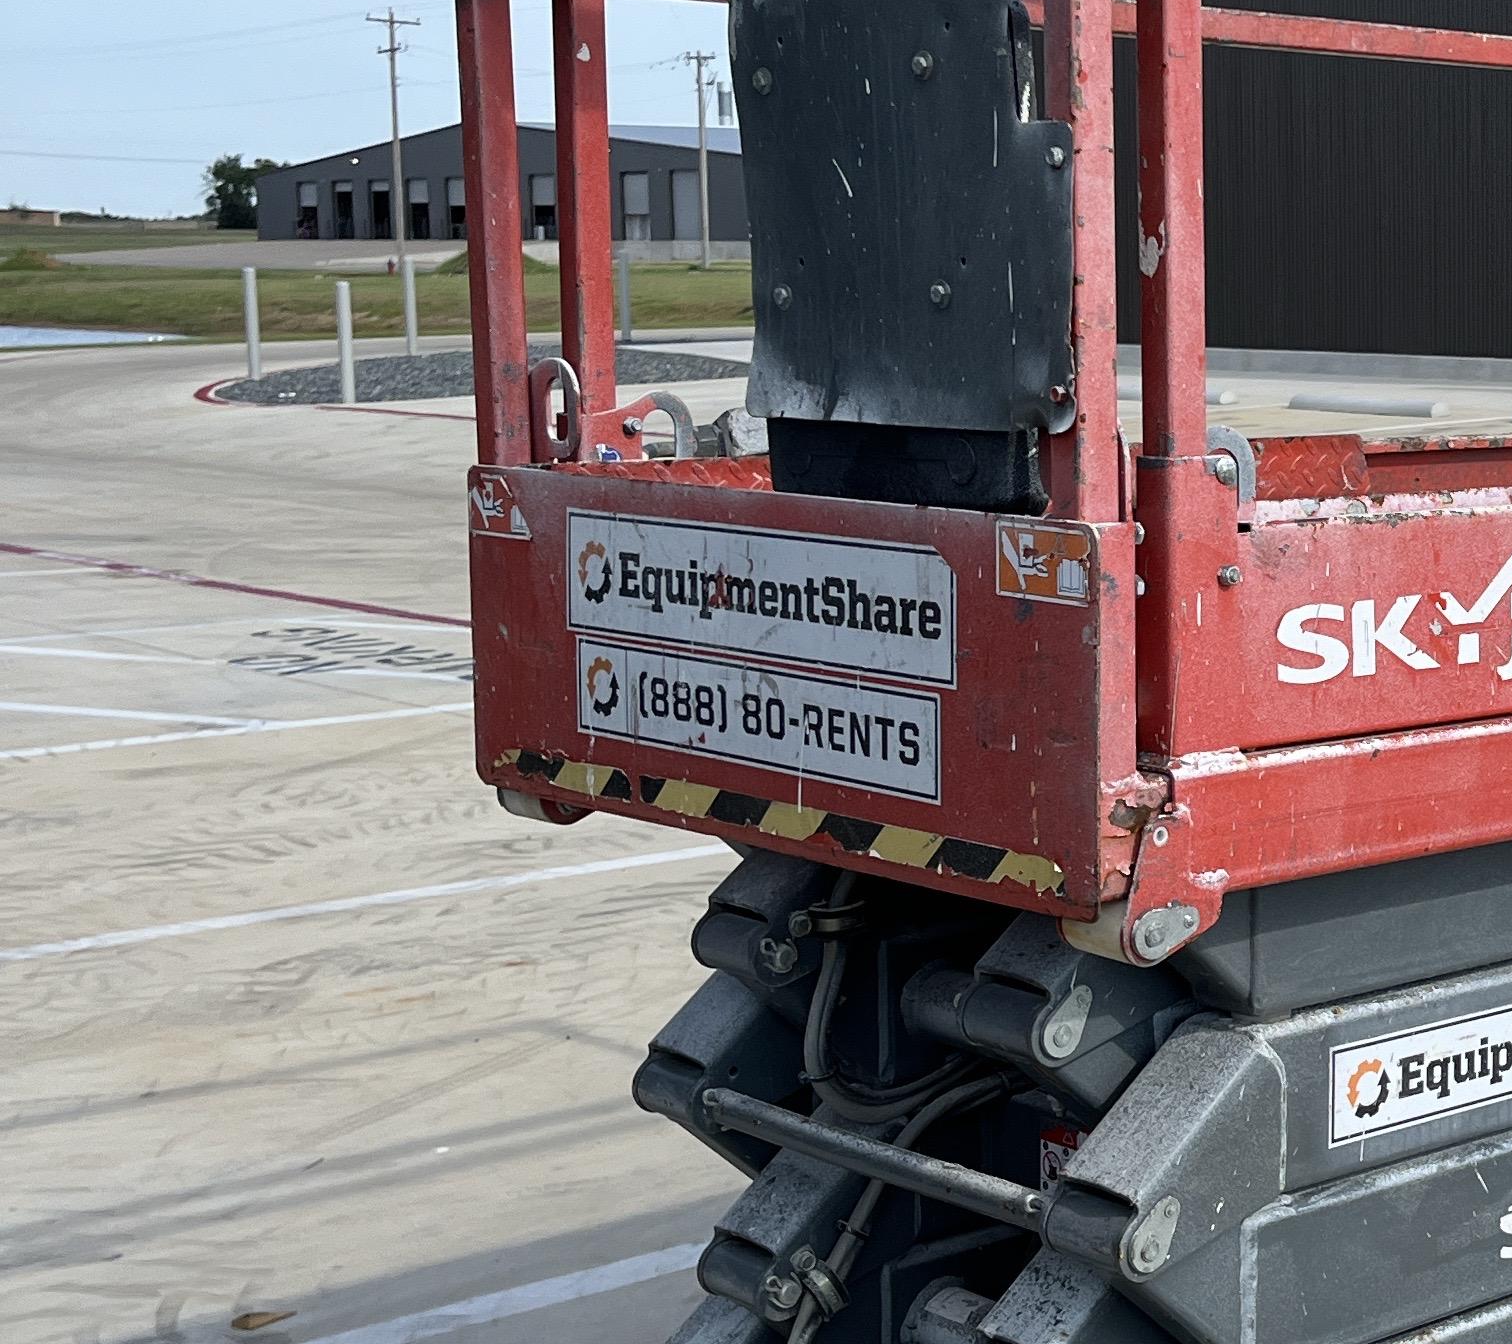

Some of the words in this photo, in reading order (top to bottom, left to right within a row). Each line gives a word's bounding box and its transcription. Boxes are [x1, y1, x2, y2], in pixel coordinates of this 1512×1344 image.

[618, 551, 942, 640] EquipmentShare
[637, 670, 728, 733] (888)
[741, 692, 922, 767] 80-RENTS
